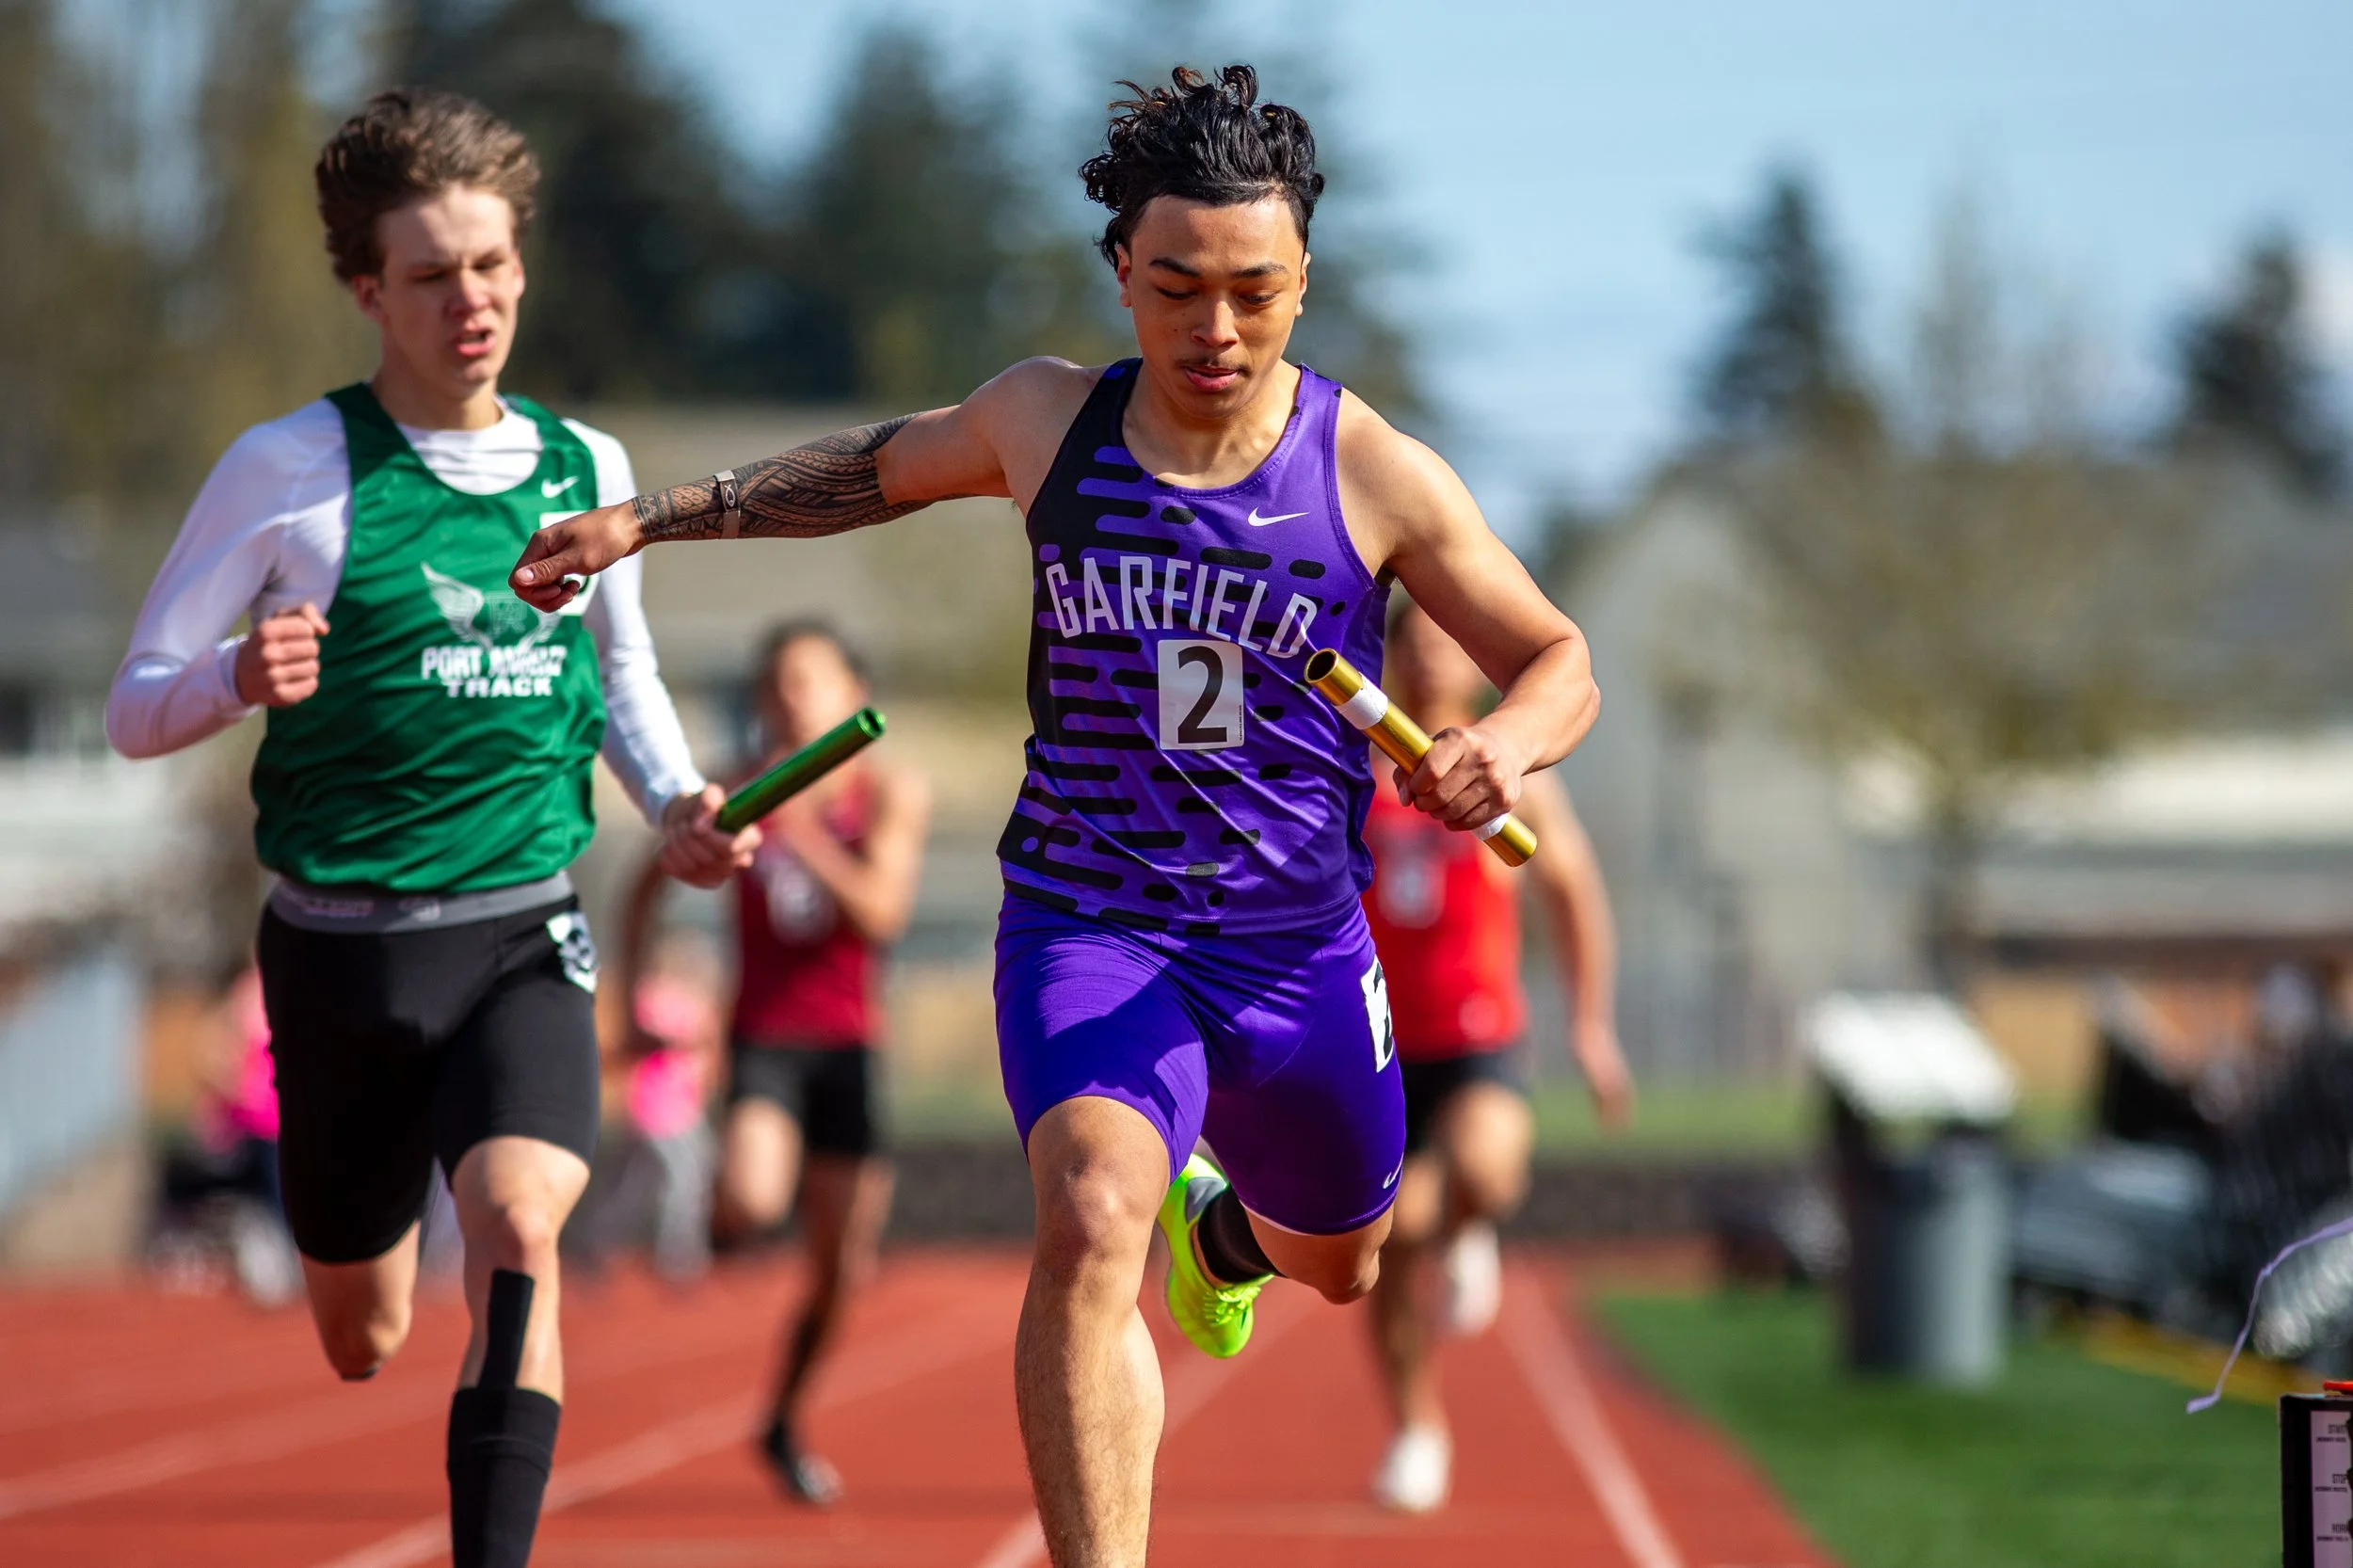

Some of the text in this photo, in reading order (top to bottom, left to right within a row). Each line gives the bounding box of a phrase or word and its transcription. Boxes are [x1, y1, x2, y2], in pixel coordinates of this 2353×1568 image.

[1046, 555, 1318, 658] GARFIELD
[422, 646, 483, 679] PORT
[443, 677, 552, 697] TRACK
[1177, 646, 1227, 744] 2
